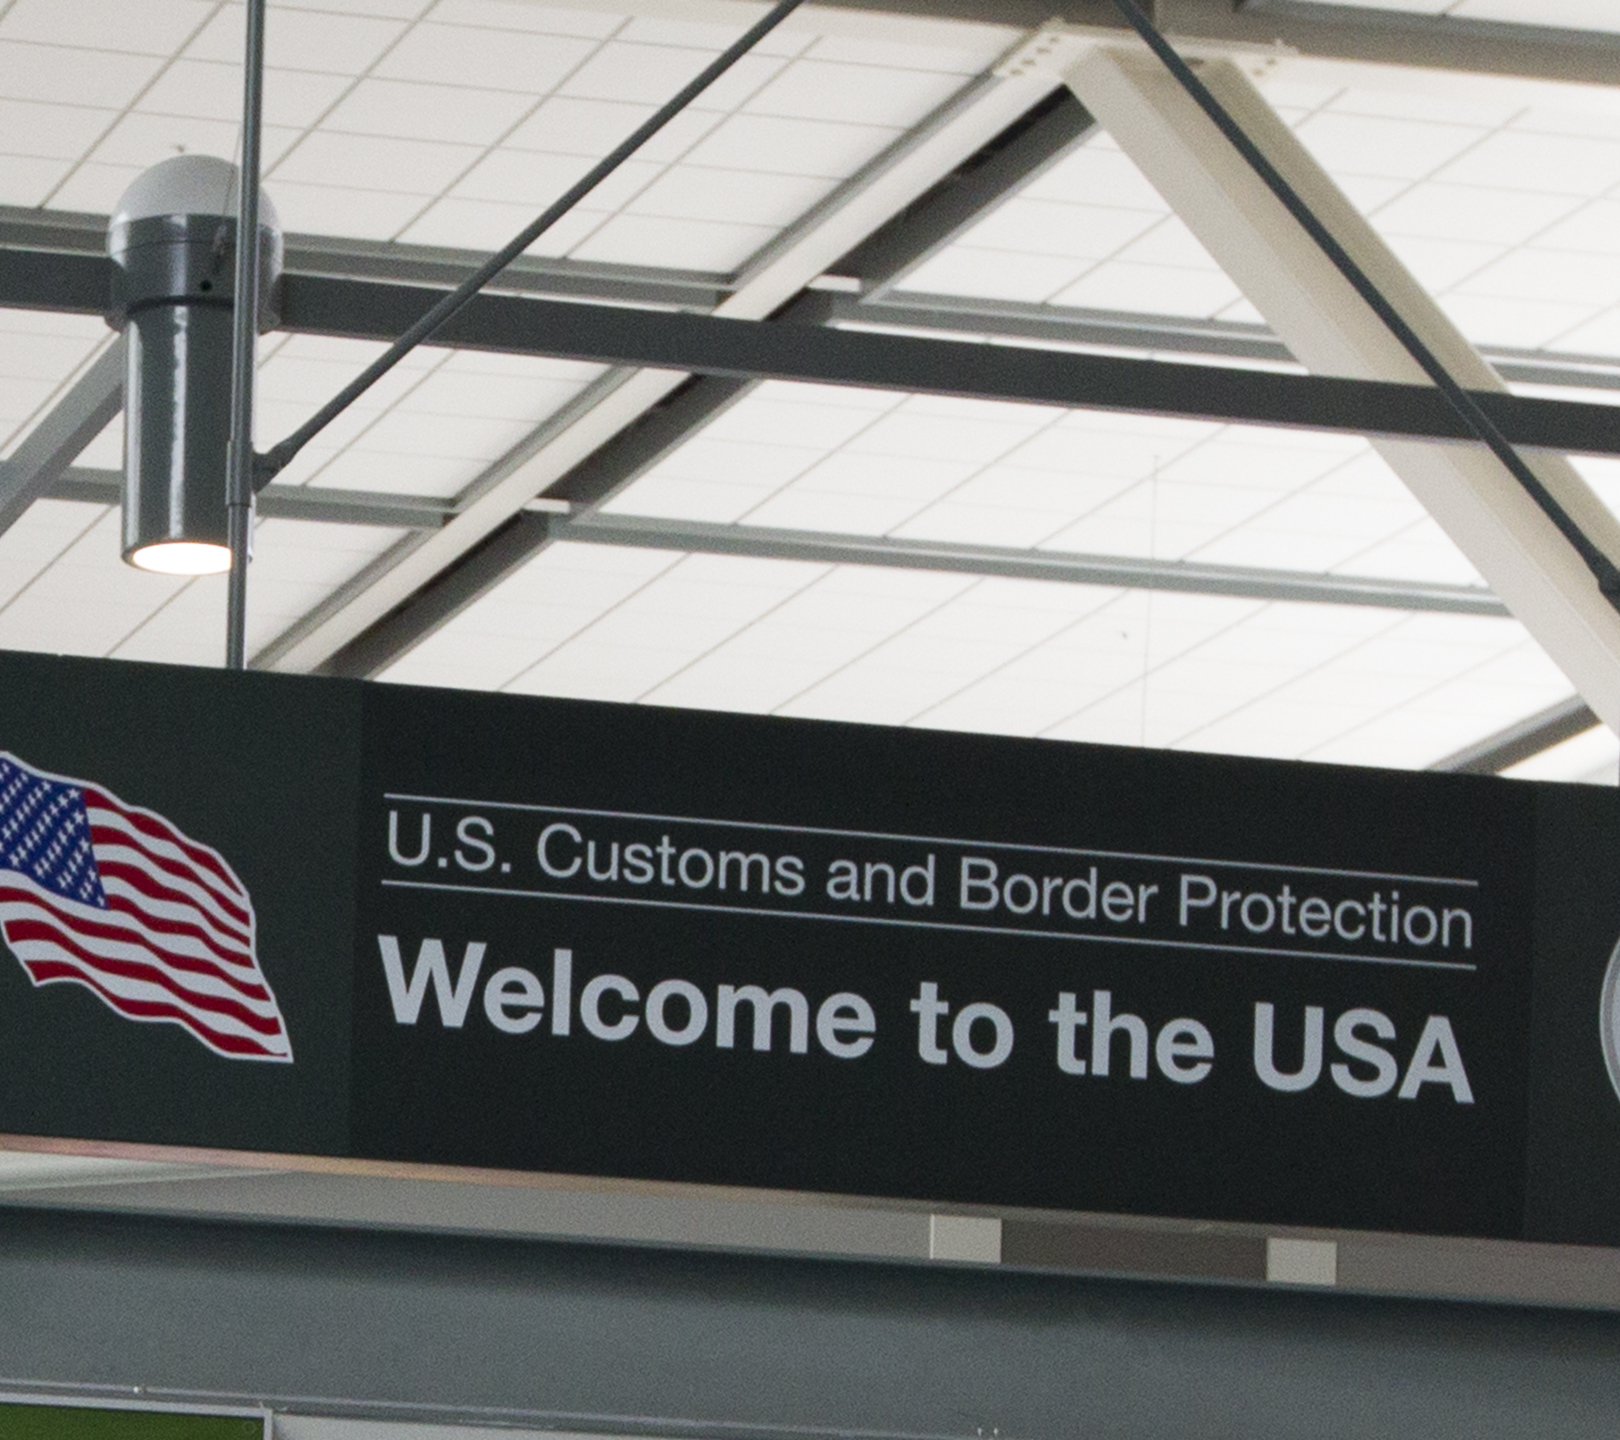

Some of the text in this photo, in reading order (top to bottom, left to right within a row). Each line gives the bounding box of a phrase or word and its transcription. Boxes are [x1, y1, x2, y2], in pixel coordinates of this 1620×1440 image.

[388, 810, 1473, 949] U.S. Customs and Border Protection
[377, 934, 1476, 1104] Welcome to the USA
